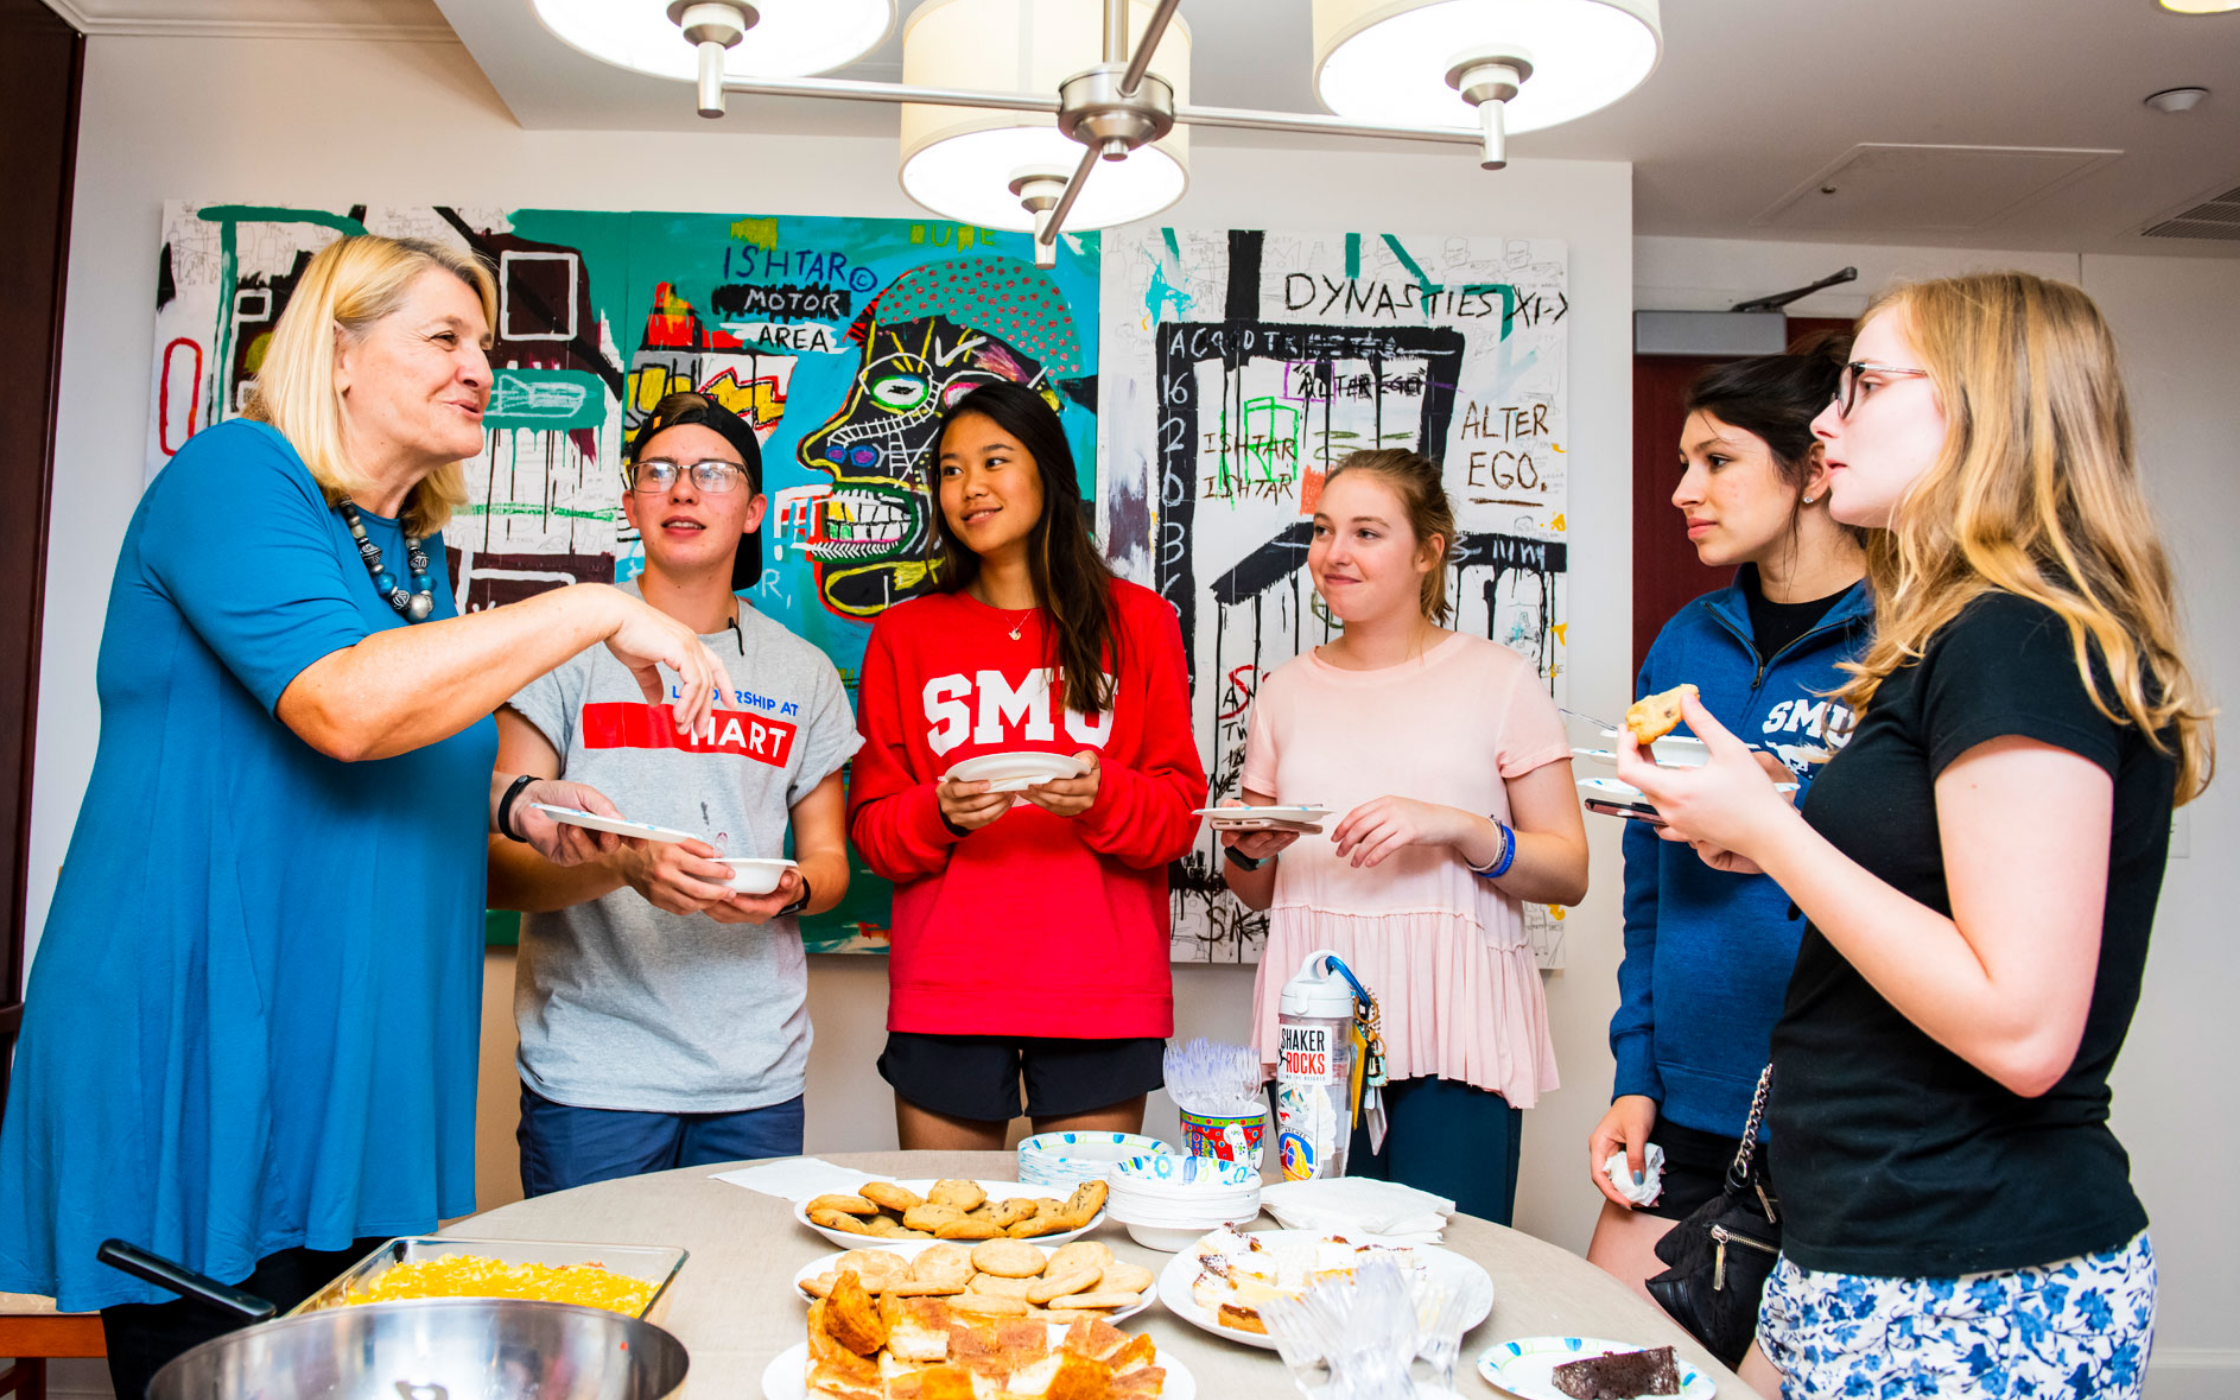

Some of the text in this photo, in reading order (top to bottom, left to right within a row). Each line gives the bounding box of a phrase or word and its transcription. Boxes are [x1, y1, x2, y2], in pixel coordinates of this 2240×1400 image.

[744, 288, 840, 314] MOTOR
[1285, 272, 1498, 319] DYNASTIES
[758, 326, 829, 352] AREA
[1461, 400, 1549, 442] ALTER
[1202, 432, 1296, 461] ISHTAR
[1467, 450, 1547, 492] EGO.
[1202, 474, 1294, 506] ISHTAR
[780, 701, 799, 717] AT
[922, 666, 1119, 757] SMU
[1762, 699, 1856, 749] SMU
[1281, 1028, 1325, 1052] SHAKER
[1286, 1051, 1326, 1075] ROCKS
